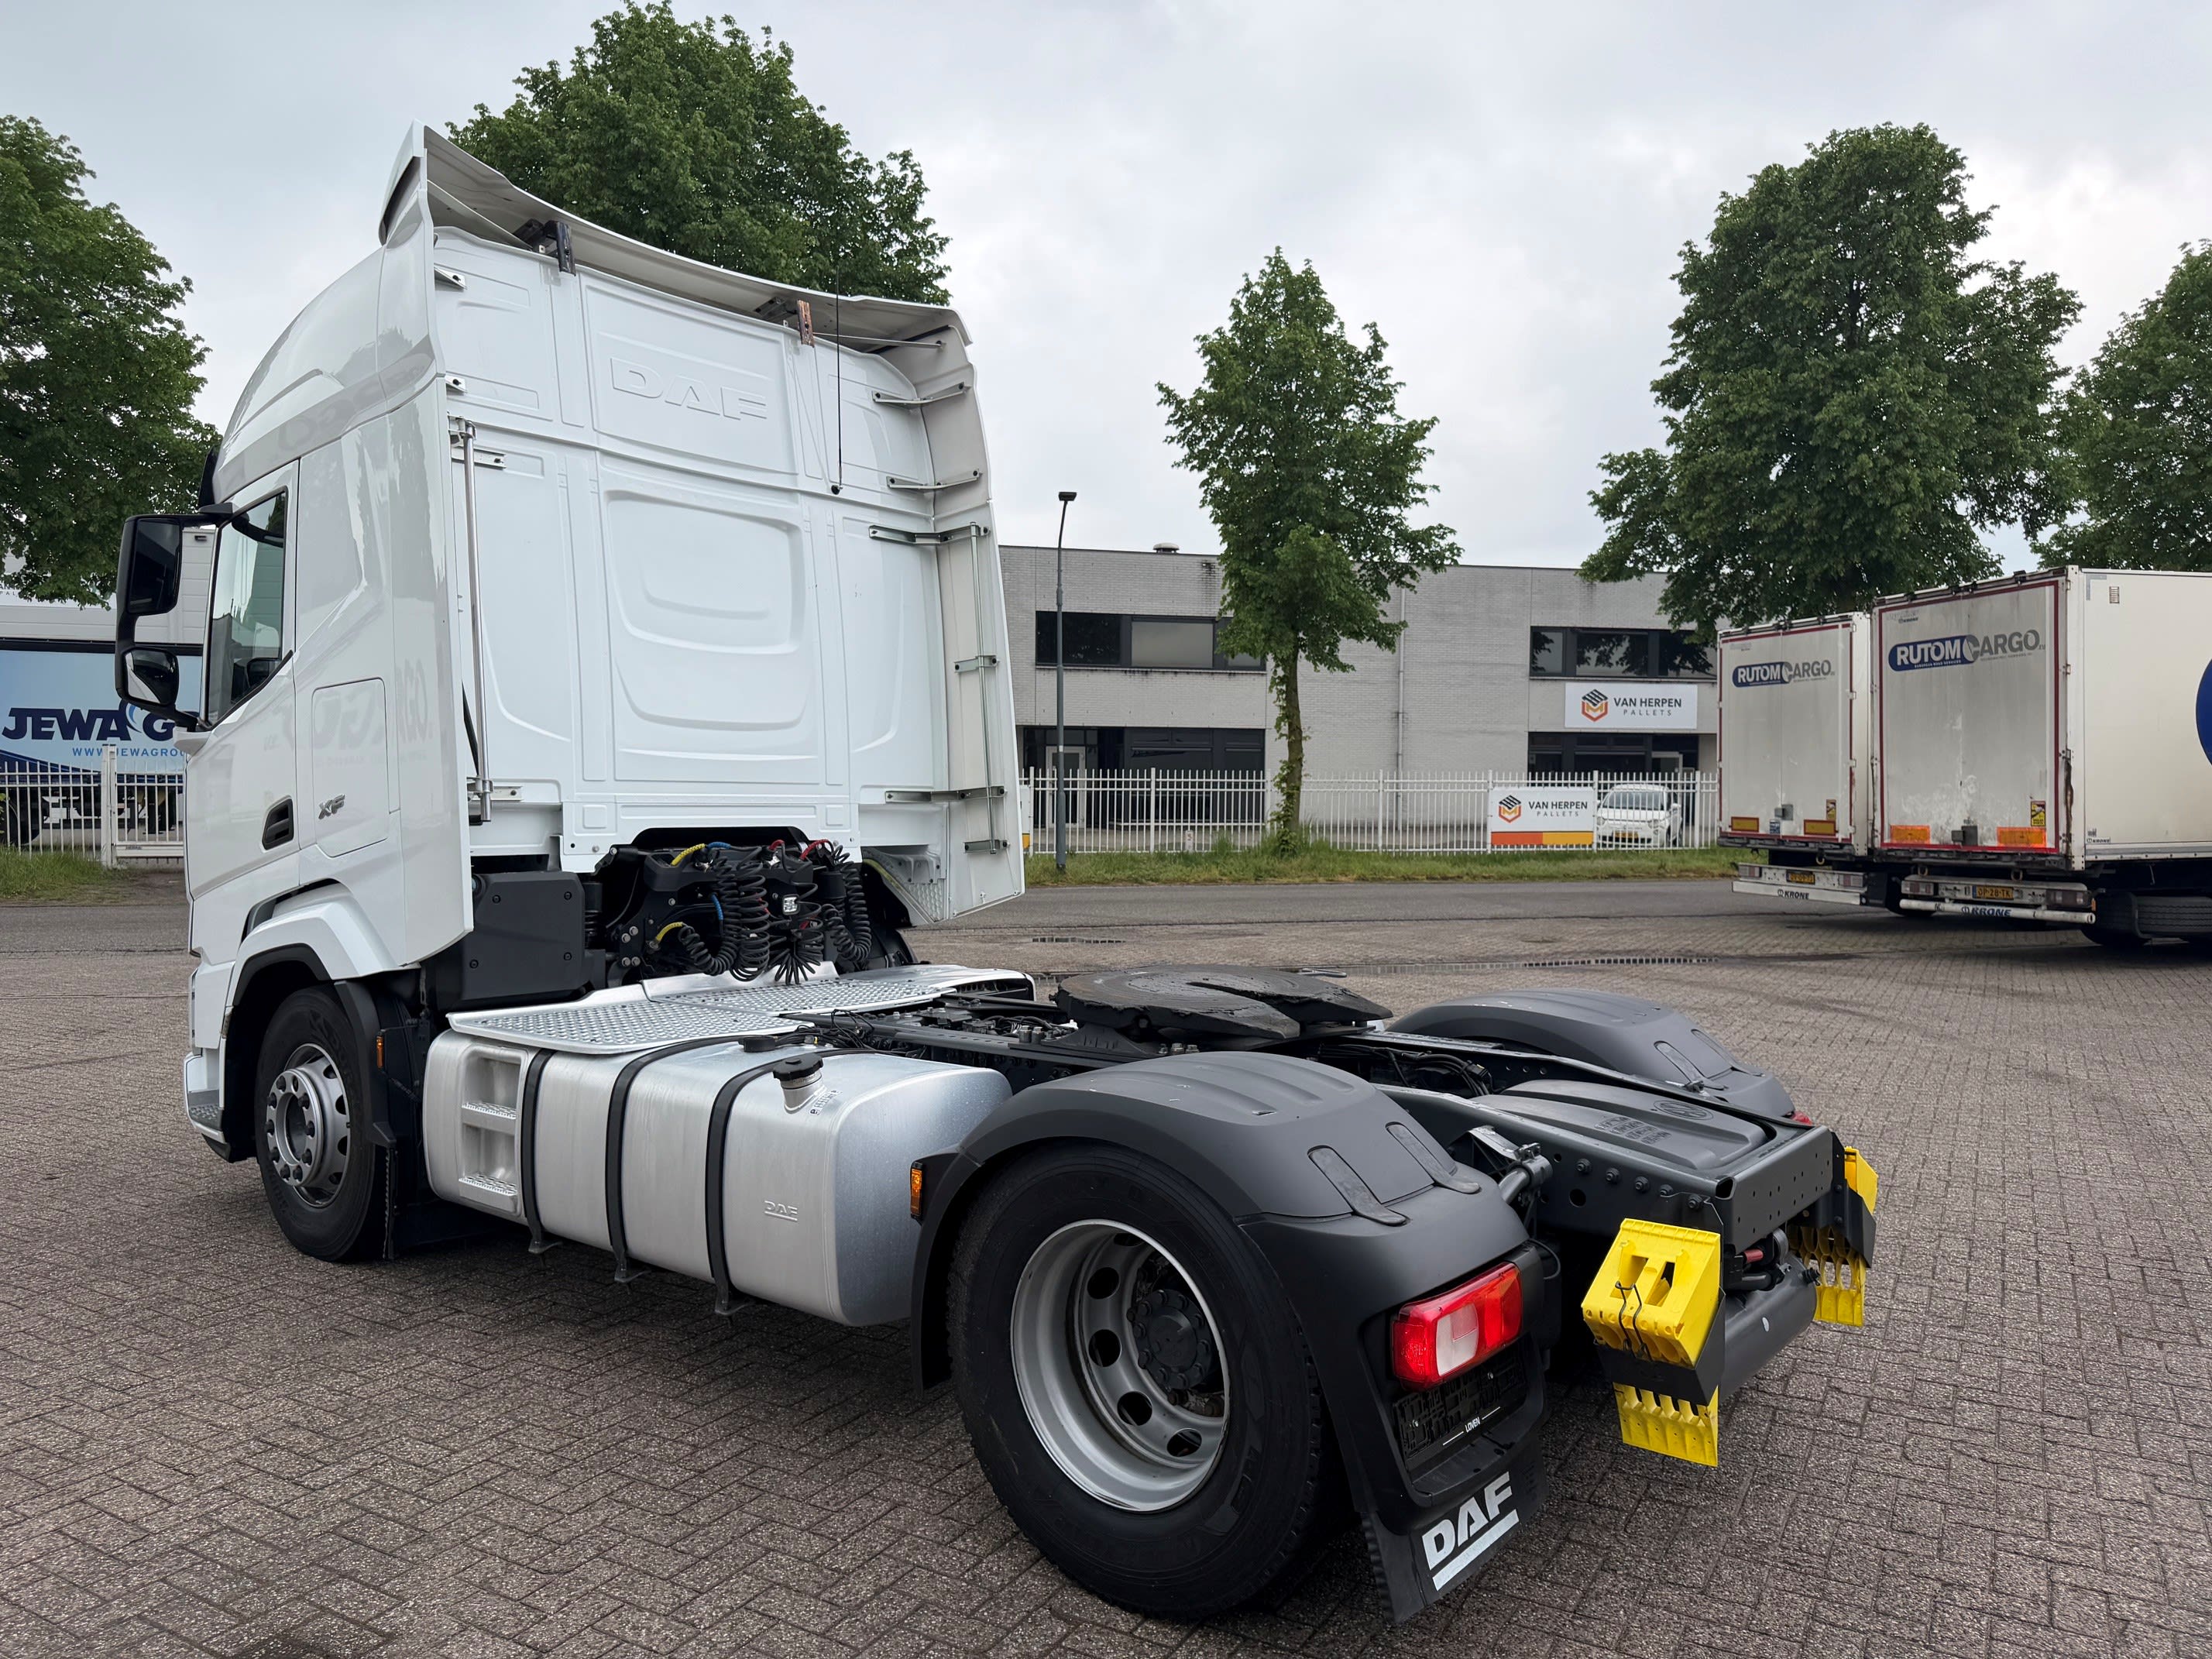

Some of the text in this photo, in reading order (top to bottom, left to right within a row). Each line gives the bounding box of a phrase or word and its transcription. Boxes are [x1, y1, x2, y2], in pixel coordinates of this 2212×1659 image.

[610, 357, 768, 421] DAF
[1613, 697, 1682, 708] VAN HERPEN
[2, 707, 132, 741] JEWA
[318, 794, 345, 819] XF
[1528, 801, 1588, 810] VAN HERPEN
[1784, 891, 1809, 899] KRONE
[1972, 907, 2011, 916] KRONE
[764, 1200, 798, 1215] DAF
[1465, 1417, 1481, 1433] LOVEN
[1421, 1472, 1513, 1571] DAF
